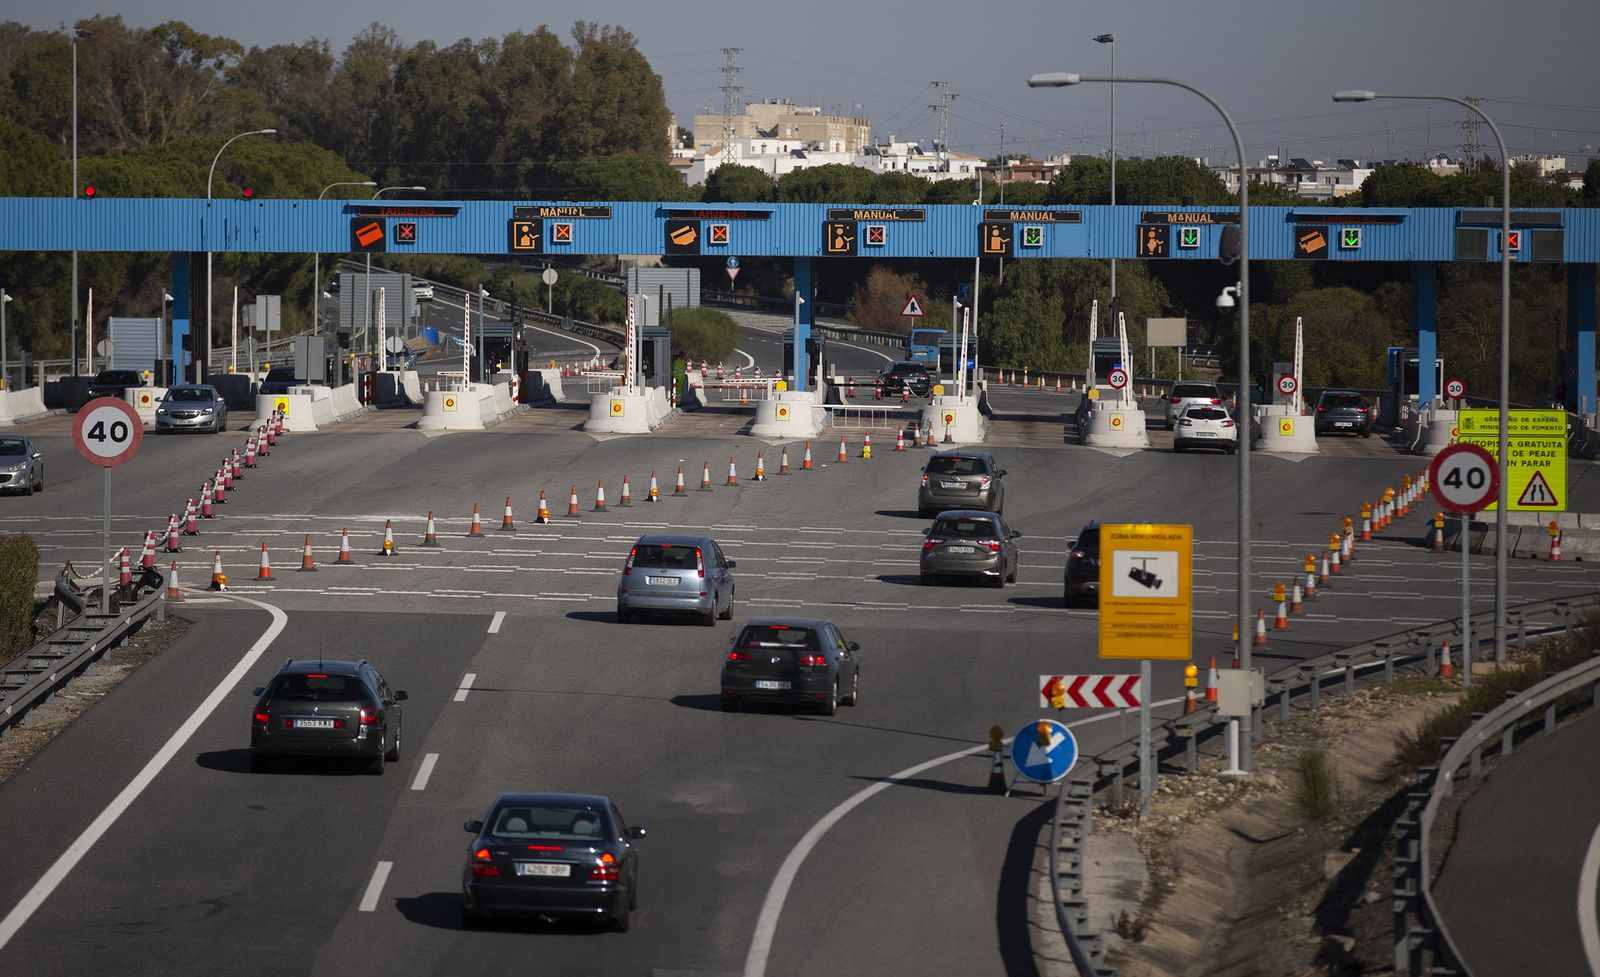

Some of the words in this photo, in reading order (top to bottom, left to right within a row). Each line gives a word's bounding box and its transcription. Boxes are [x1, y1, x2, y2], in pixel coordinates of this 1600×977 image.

[381, 207, 434, 216] TARJETAS
[854, 210, 899, 220] MANUAL
[1010, 211, 1056, 221] MANUAL
[1168, 213, 1214, 223] MANUAL
[1112, 375, 1124, 383] 30
[87, 420, 128, 443] 40
[1517, 440, 1563, 448] GRATUITA
[1443, 467, 1486, 489] 40
[527, 865, 548, 874] 4292
